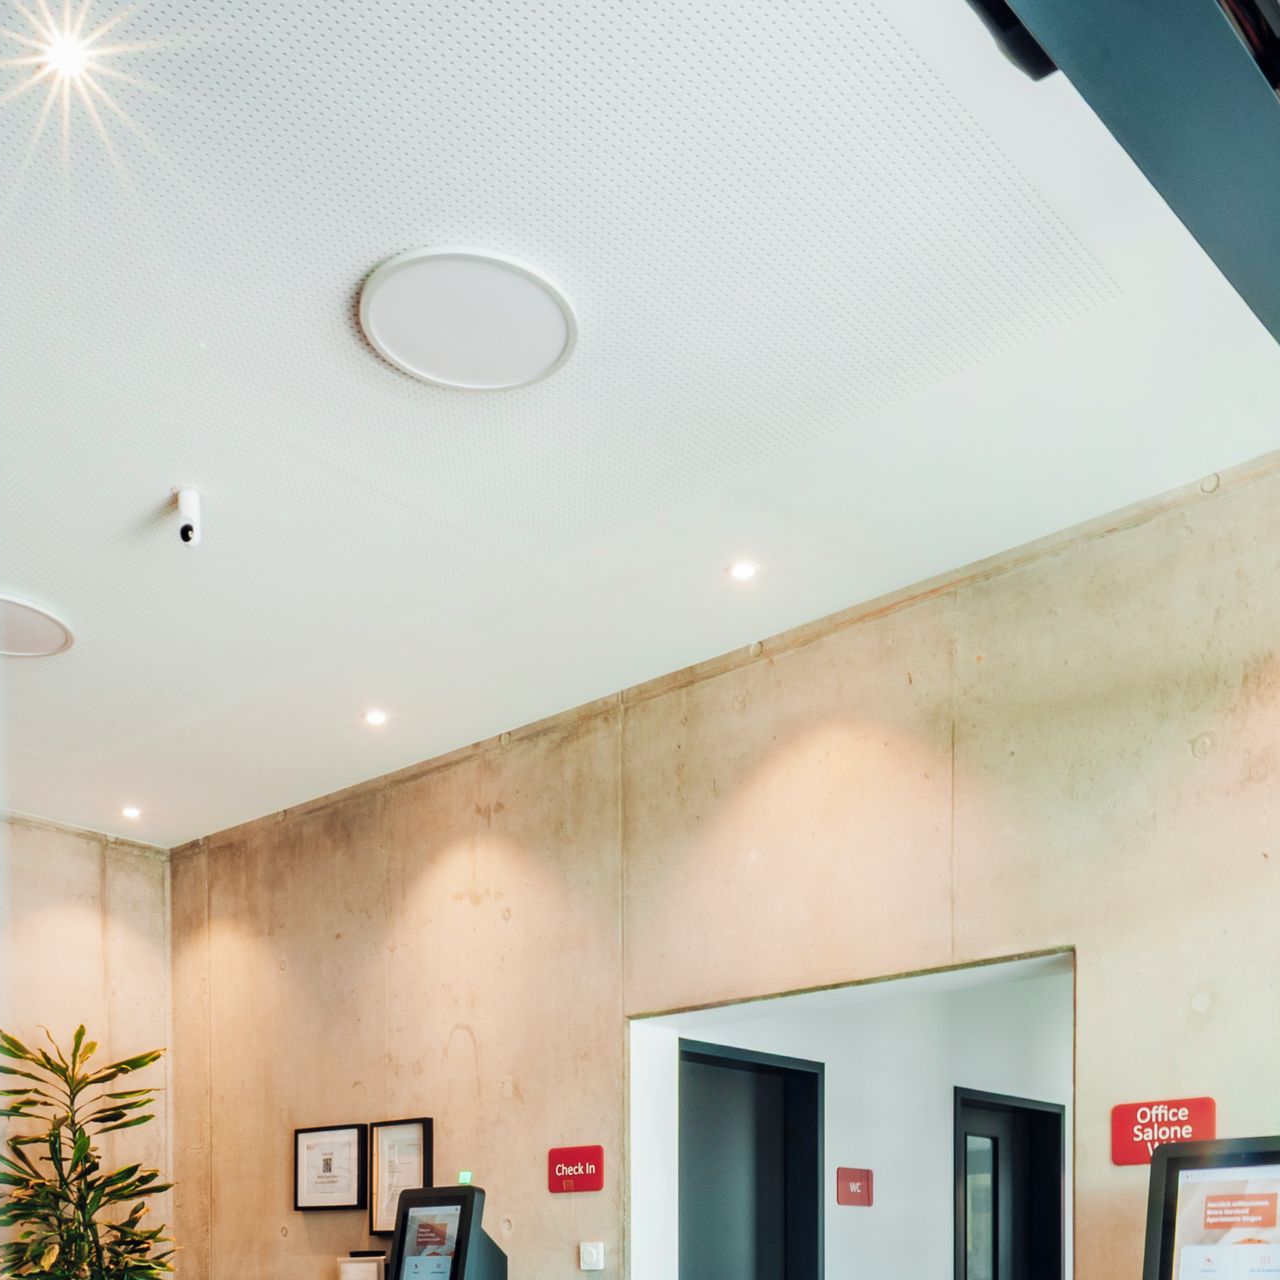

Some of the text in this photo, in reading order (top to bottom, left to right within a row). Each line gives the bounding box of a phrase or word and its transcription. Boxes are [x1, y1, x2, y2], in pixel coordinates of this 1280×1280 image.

[1137, 1104, 1189, 1124] Office
[1133, 1123, 1193, 1142] Salone
[555, 1162, 596, 1176] Check In
[849, 1182, 861, 1192] WC
